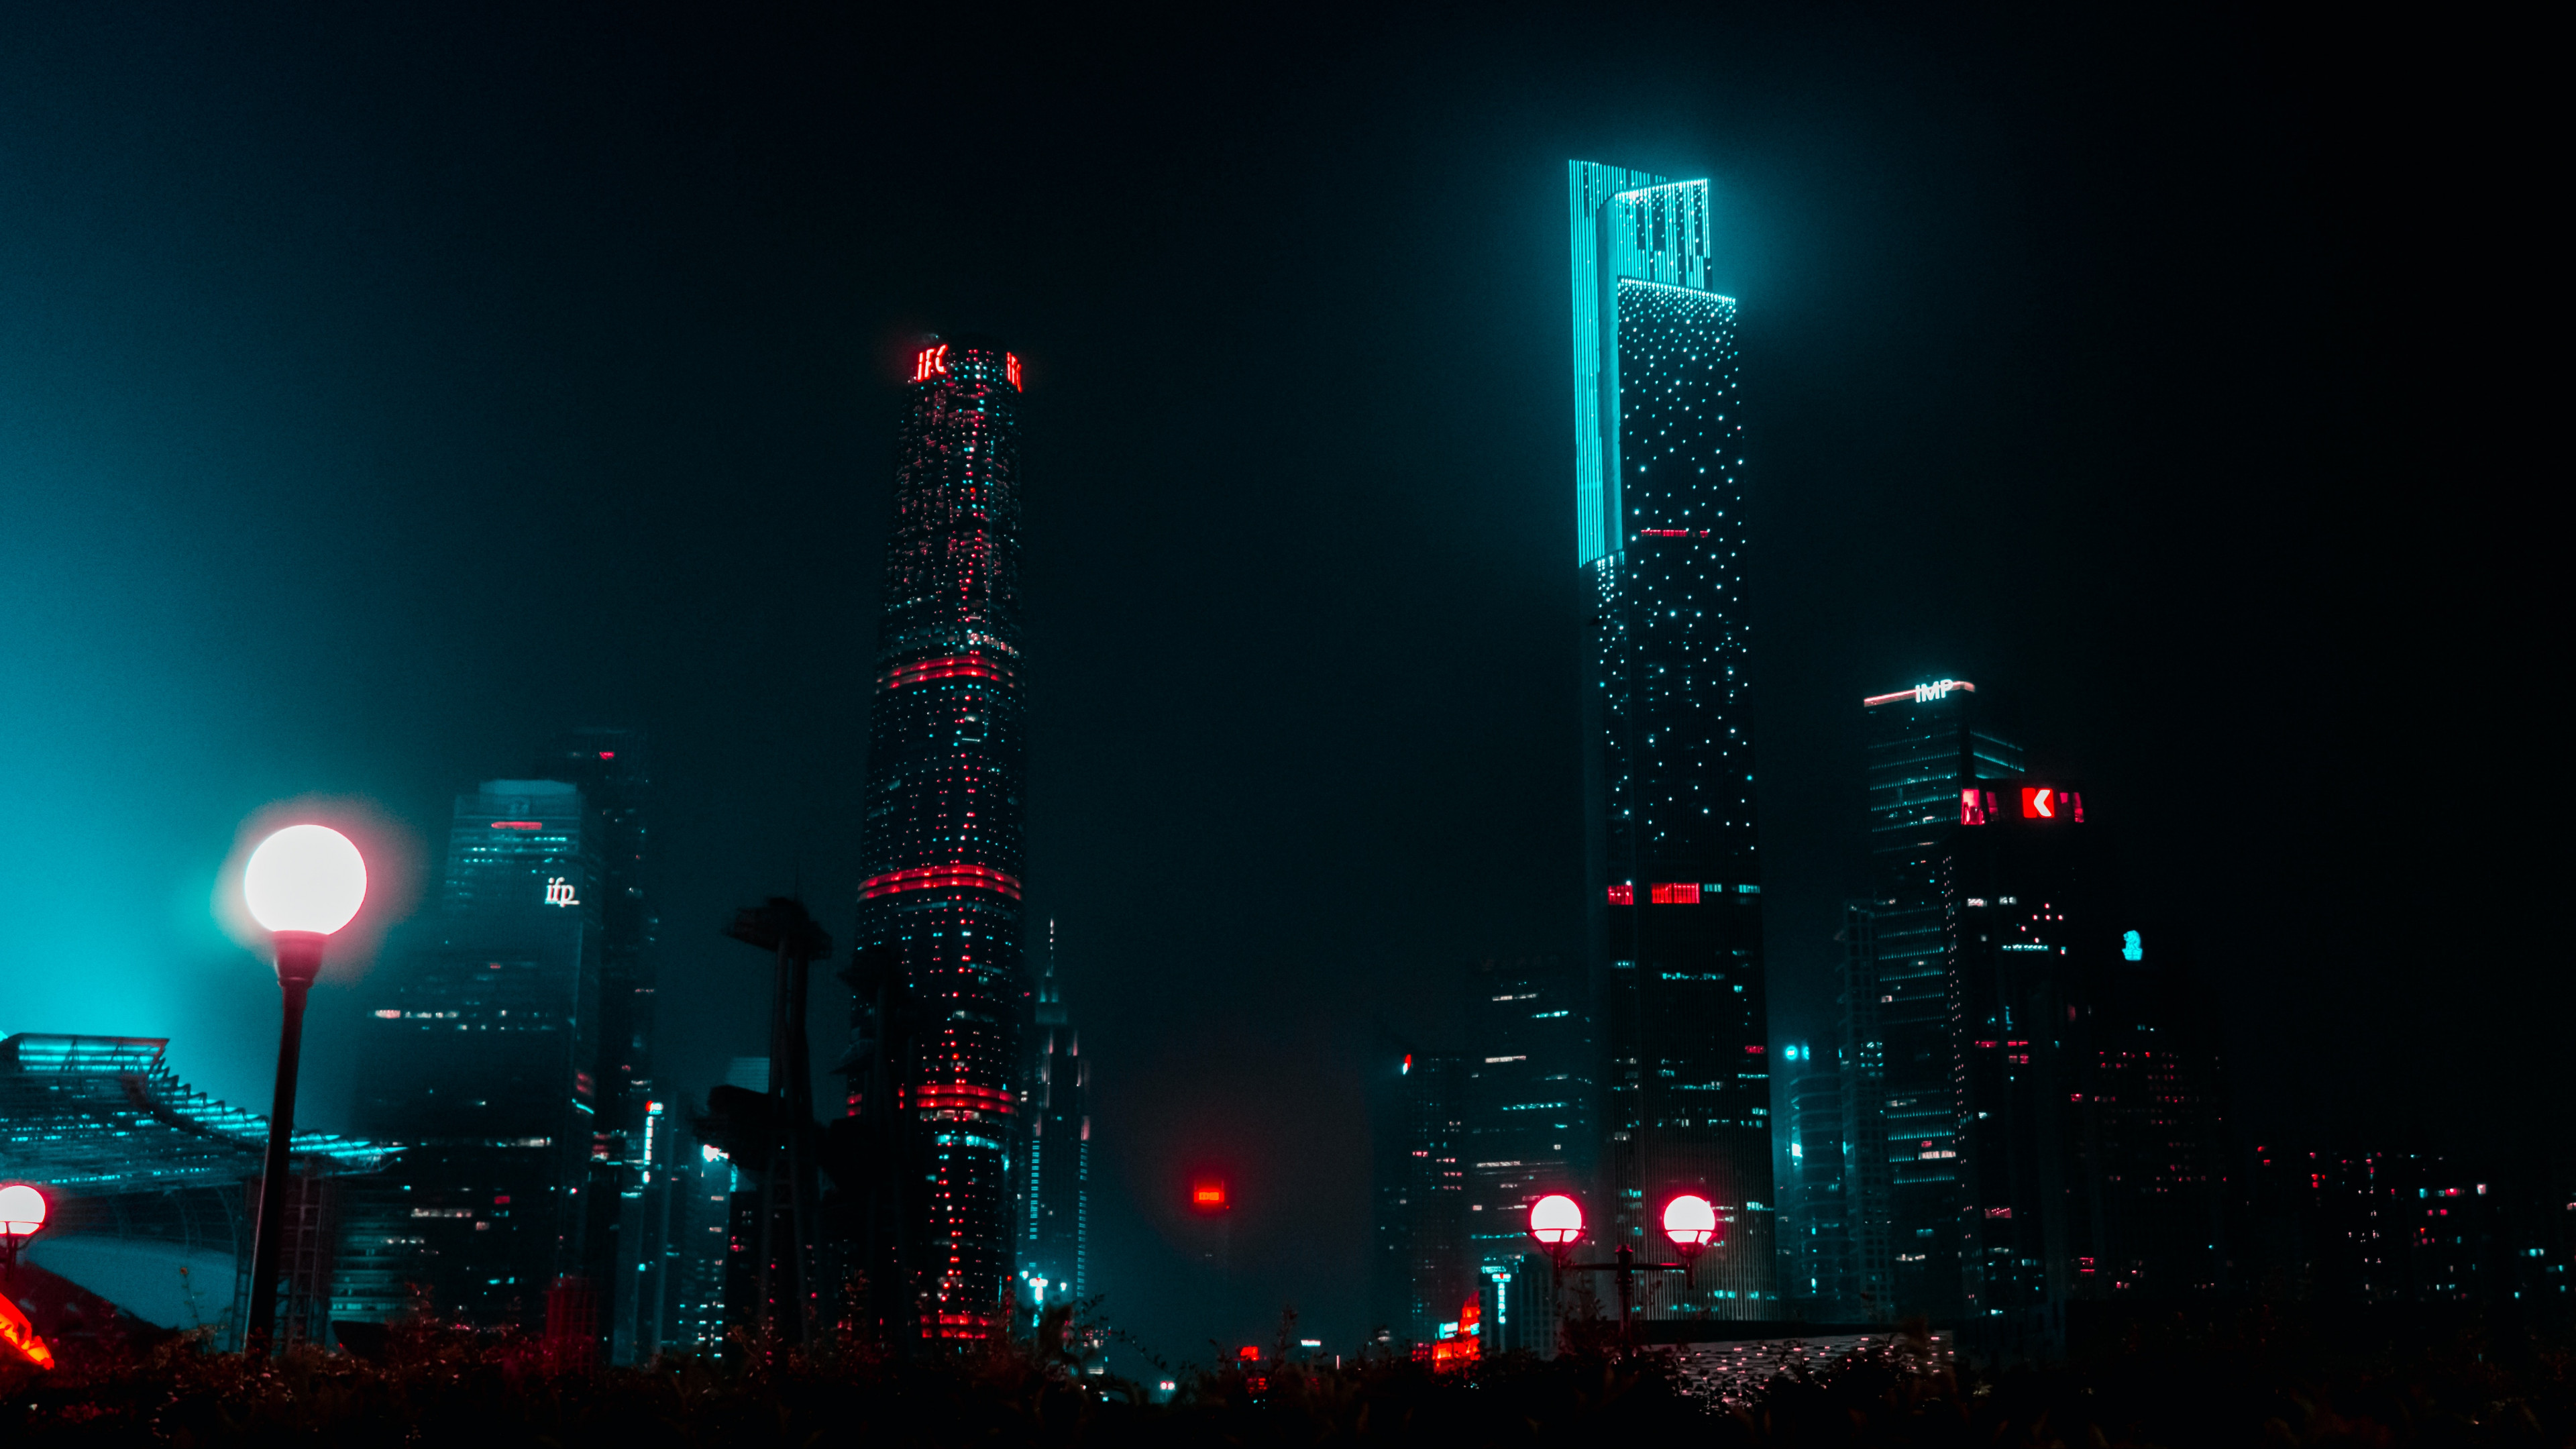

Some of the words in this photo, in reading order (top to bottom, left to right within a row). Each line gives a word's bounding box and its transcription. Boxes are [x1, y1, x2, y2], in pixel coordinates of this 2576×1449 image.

[917, 343, 948, 382] IFC
[1915, 679, 1953, 703] IMP
[545, 877, 580, 908] ifp
